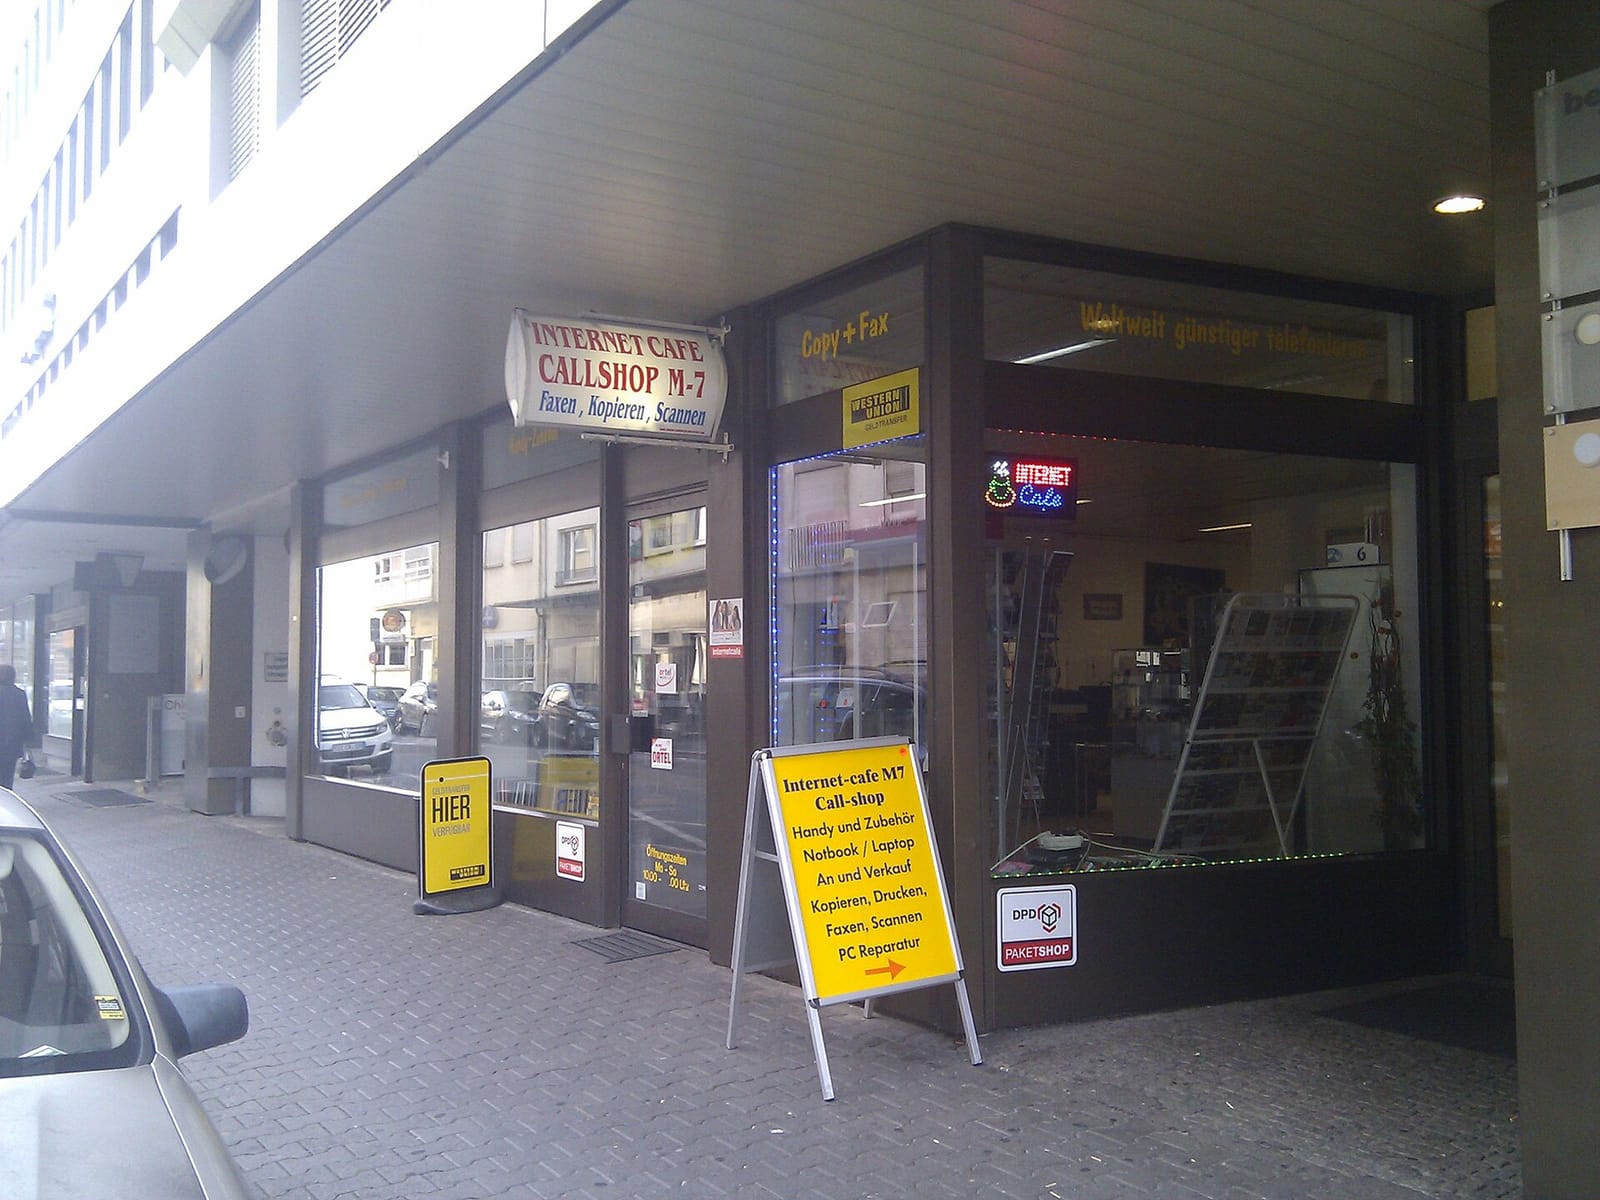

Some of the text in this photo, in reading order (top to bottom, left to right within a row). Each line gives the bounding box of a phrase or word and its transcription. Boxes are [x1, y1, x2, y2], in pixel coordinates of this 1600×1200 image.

[801, 310, 888, 362] Copy + Fax
[1080, 302, 1166, 338] Weltweit
[1174, 316, 1260, 354] günstiger
[532, 321, 704, 363] INTERNET CAFE
[538, 354, 706, 398] CALLSHOP M-7
[852, 388, 900, 411] WESTERN
[866, 401, 900, 419] UNION
[654, 401, 706, 426] Scannen
[653, 751, 671, 764] ORTEL
[783, 766, 905, 793] Internet-cafe M7
[432, 794, 470, 823] HIER
[815, 792, 885, 811] Call-shop
[792, 811, 915, 839] Handy und Zubehör
[803, 838, 915, 863] Notbook / Laptop
[655, 861, 664, 873] Mo
[668, 864, 677, 877] So
[817, 859, 912, 886] An und Verkauf
[679, 879, 690, 891] Uhr
[811, 886, 927, 914] Kopieren, Drucken,
[826, 912, 923, 937] Faxen, Scannen
[1012, 908, 1037, 920] DPD
[838, 937, 920, 961] PC Reparatur
[1005, 944, 1069, 960] PAKETSHOP
